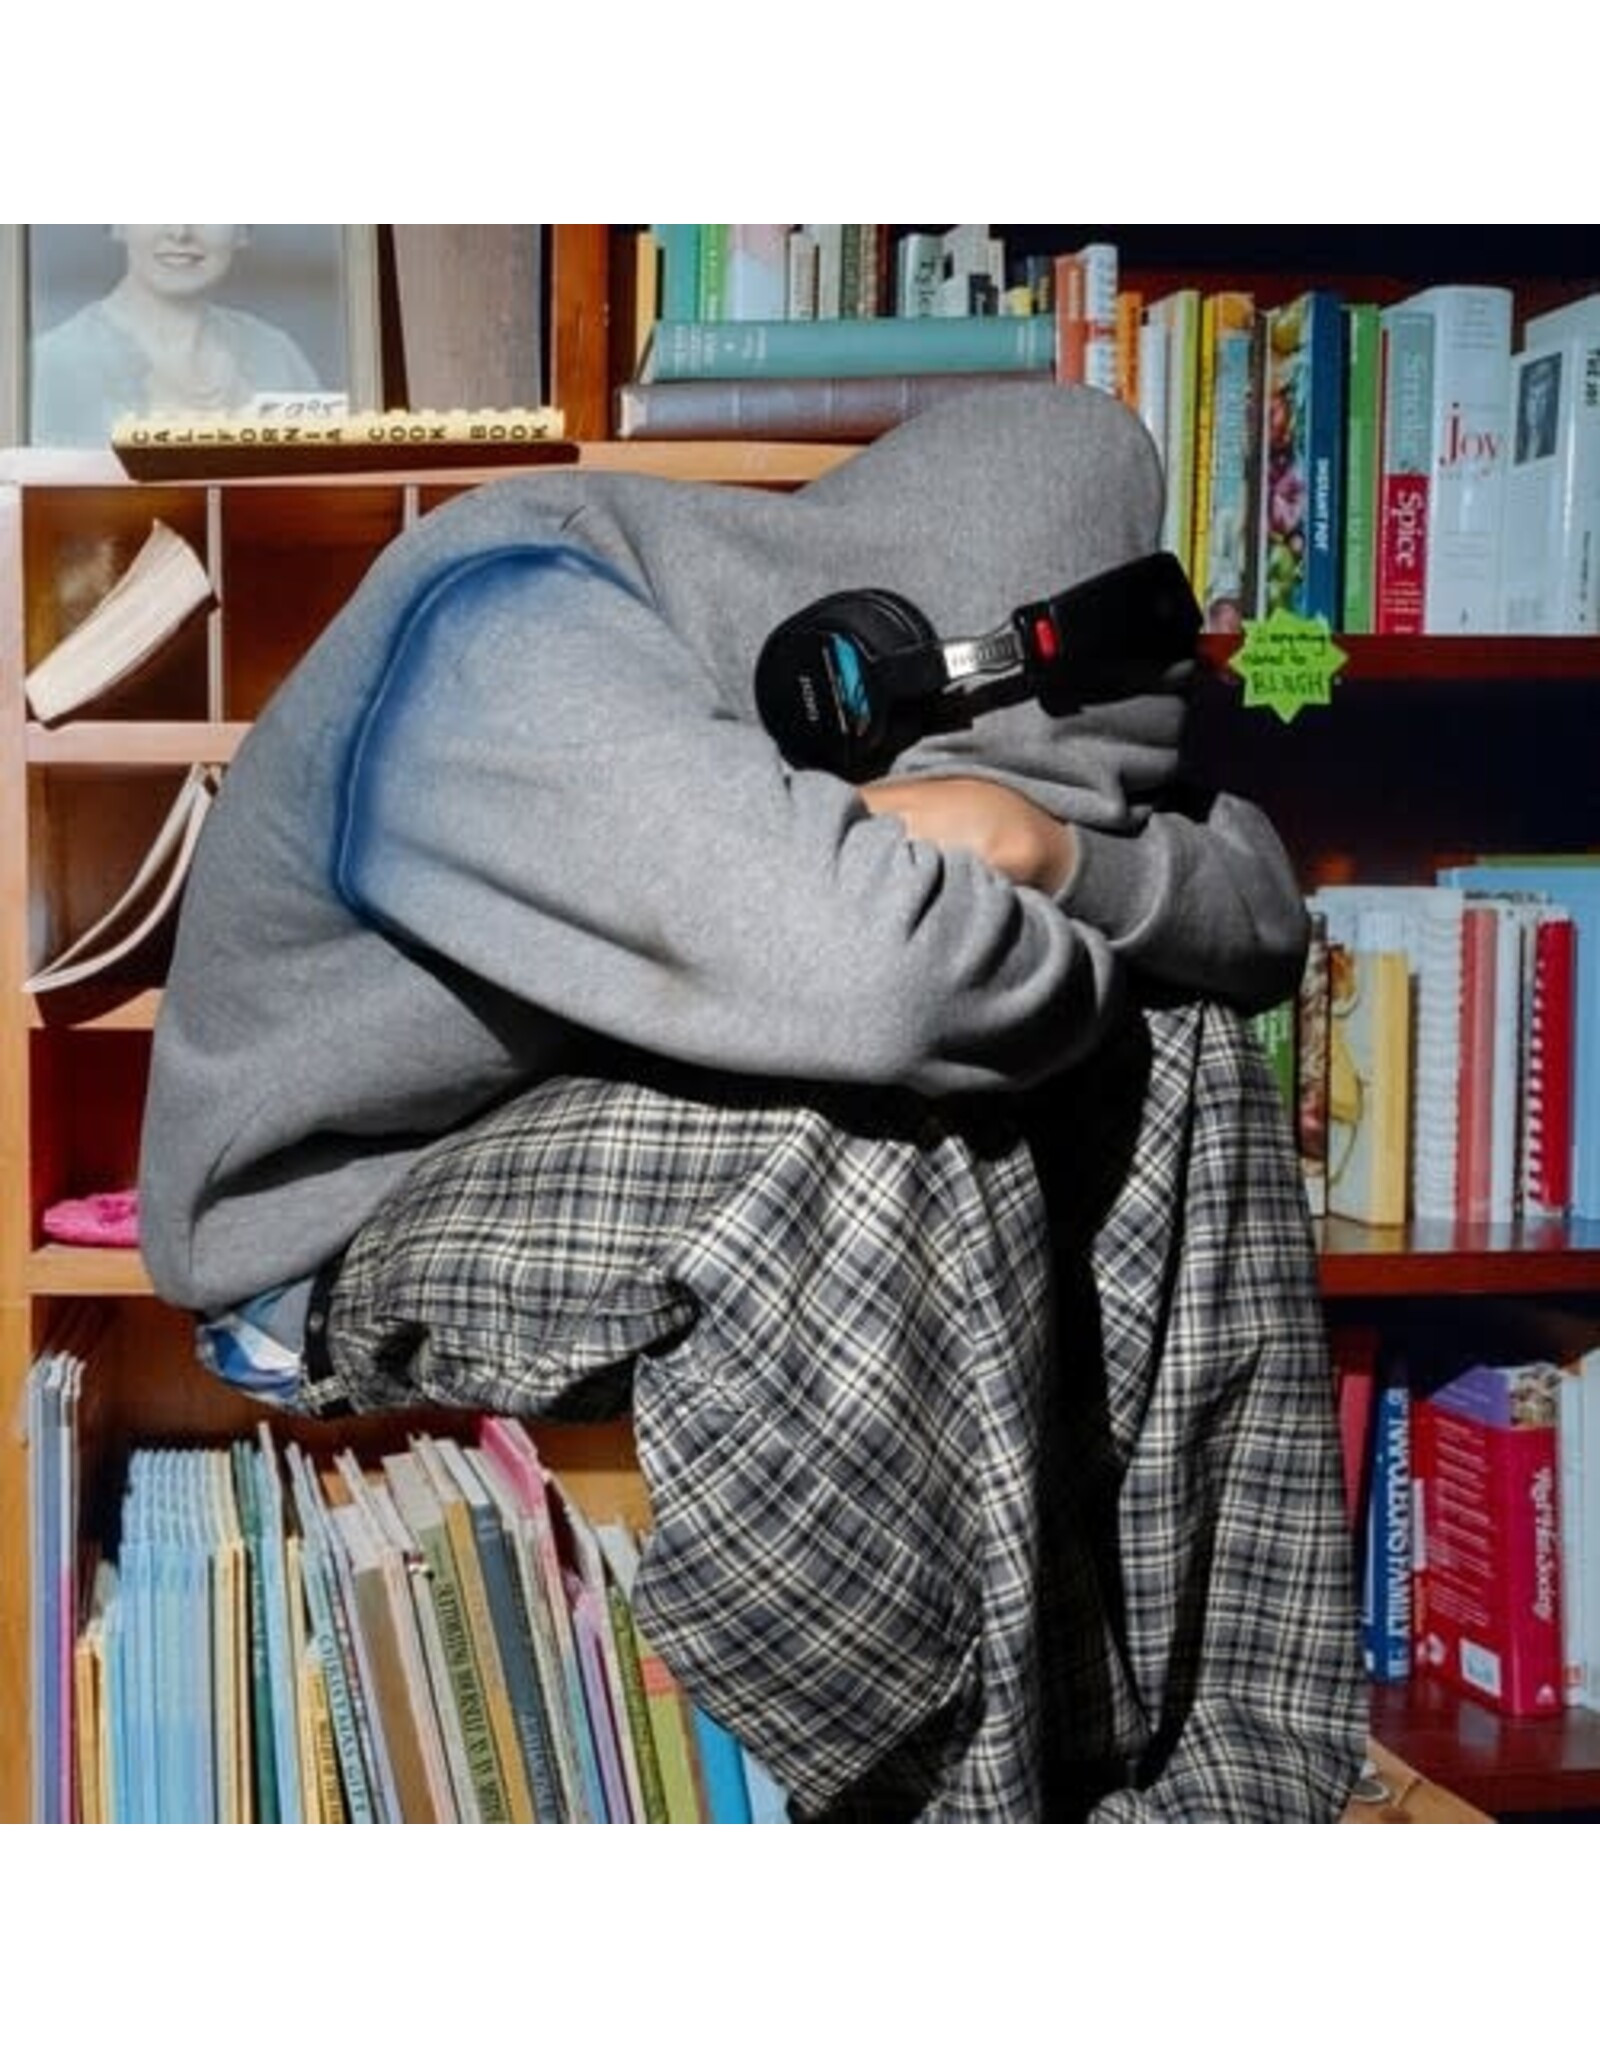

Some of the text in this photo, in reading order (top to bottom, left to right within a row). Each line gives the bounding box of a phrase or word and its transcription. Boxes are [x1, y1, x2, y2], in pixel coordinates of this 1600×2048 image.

[131, 423, 548, 444] CALIFORNIA COOK BOOK
[1391, 489, 1423, 569] Spice
